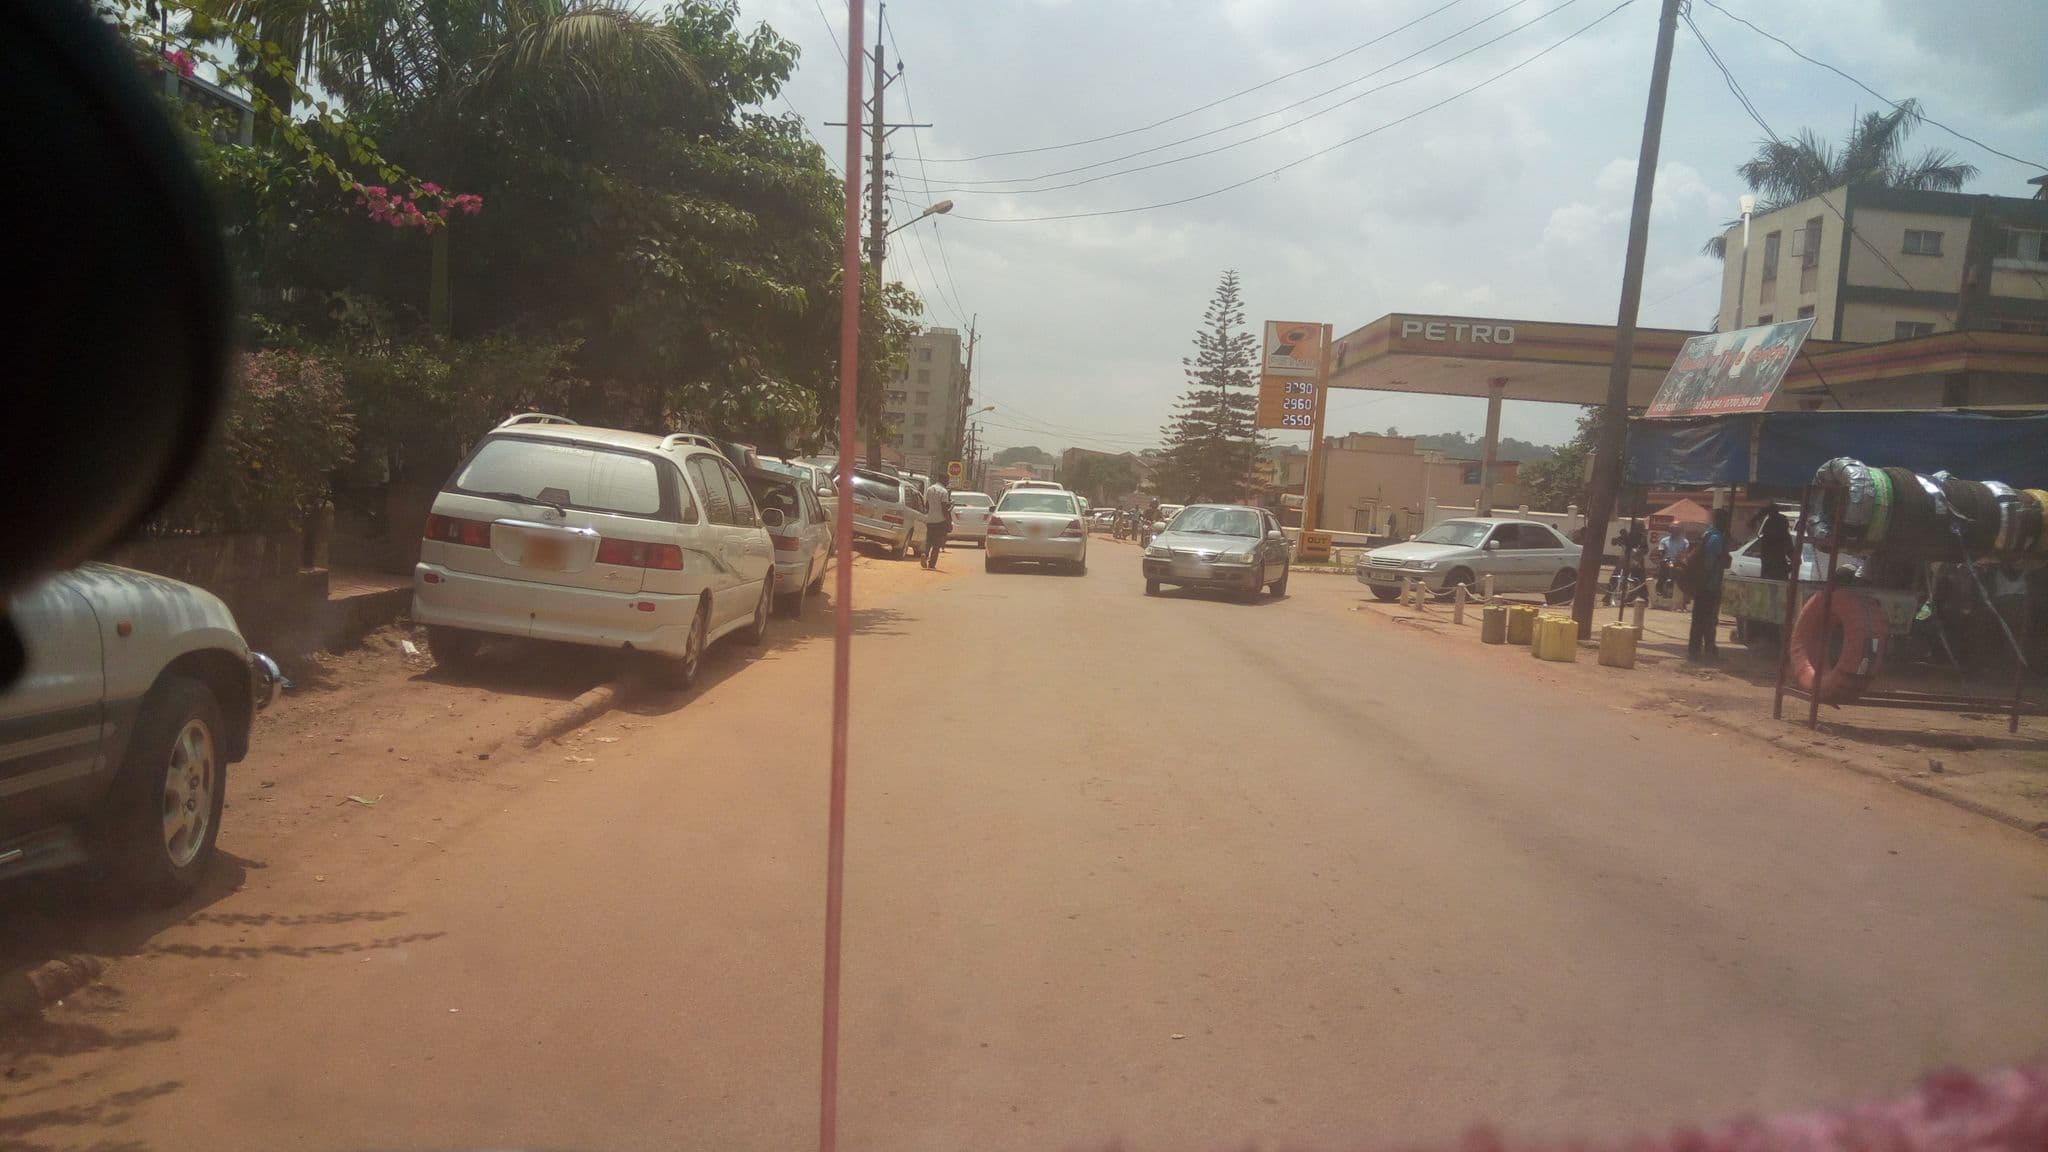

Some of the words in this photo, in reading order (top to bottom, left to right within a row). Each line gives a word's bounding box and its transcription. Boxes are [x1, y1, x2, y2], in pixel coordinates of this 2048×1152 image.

[1401, 320, 1516, 344] PETRO
[1285, 382, 1313, 394] 3790
[1283, 398, 1312, 410] 2960
[1282, 414, 1311, 426] 2550
[1307, 536, 1329, 544] OUT
